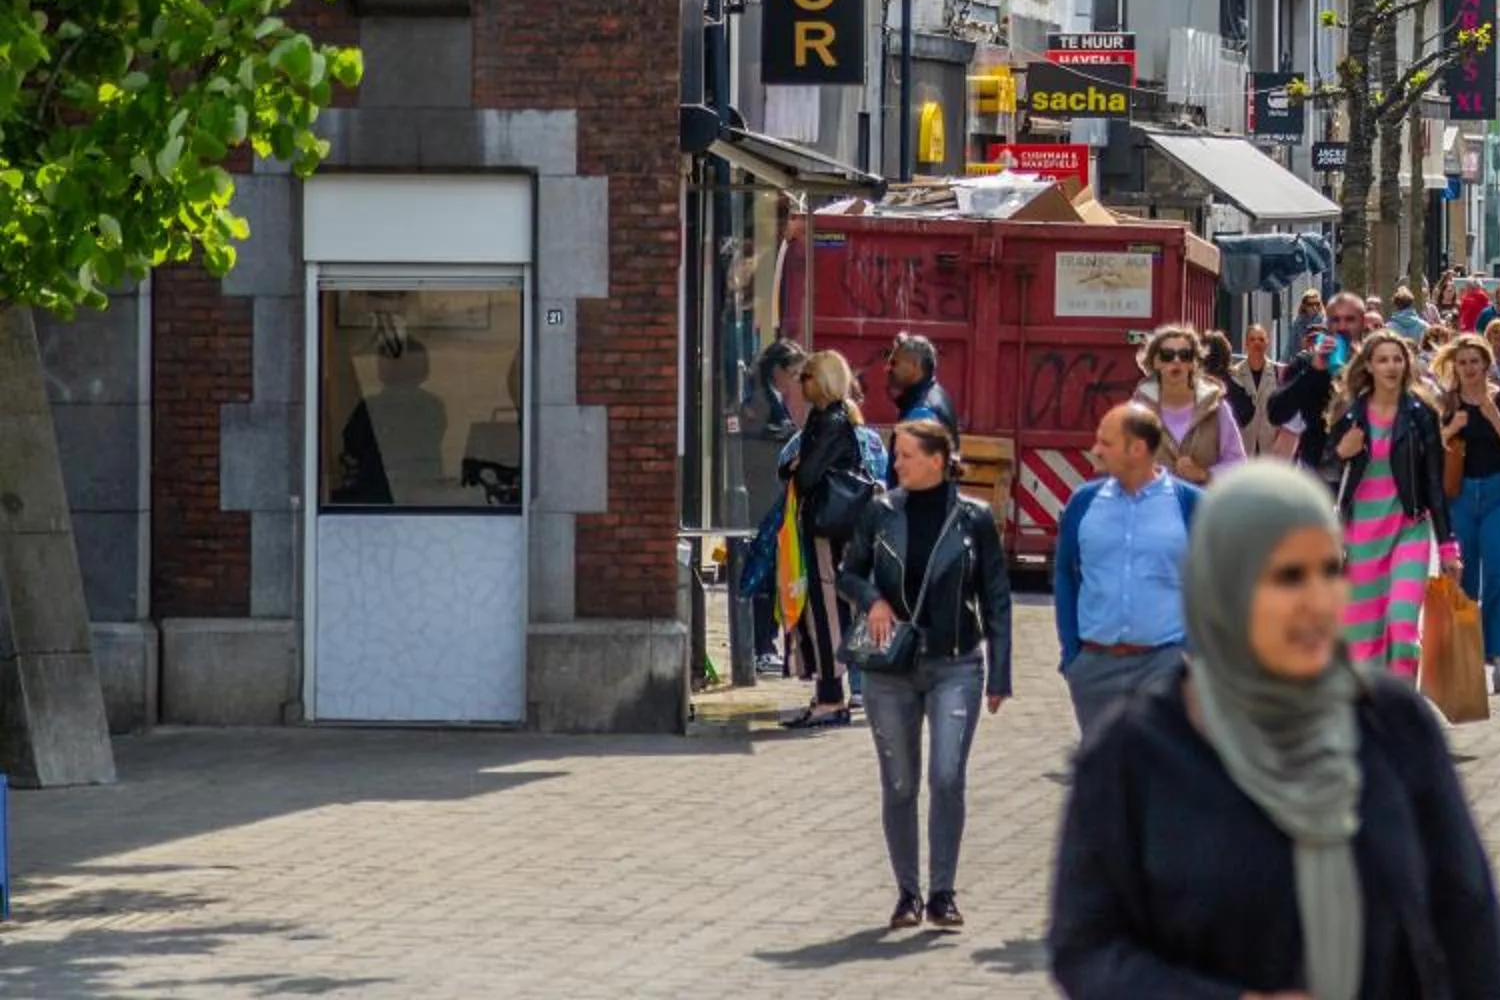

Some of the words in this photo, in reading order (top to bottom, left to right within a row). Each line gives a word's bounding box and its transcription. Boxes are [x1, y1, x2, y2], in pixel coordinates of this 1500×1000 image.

[1059, 36, 1079, 49] TE
[1081, 36, 1125, 49] HUUR
[1031, 86, 1126, 112] sacha
